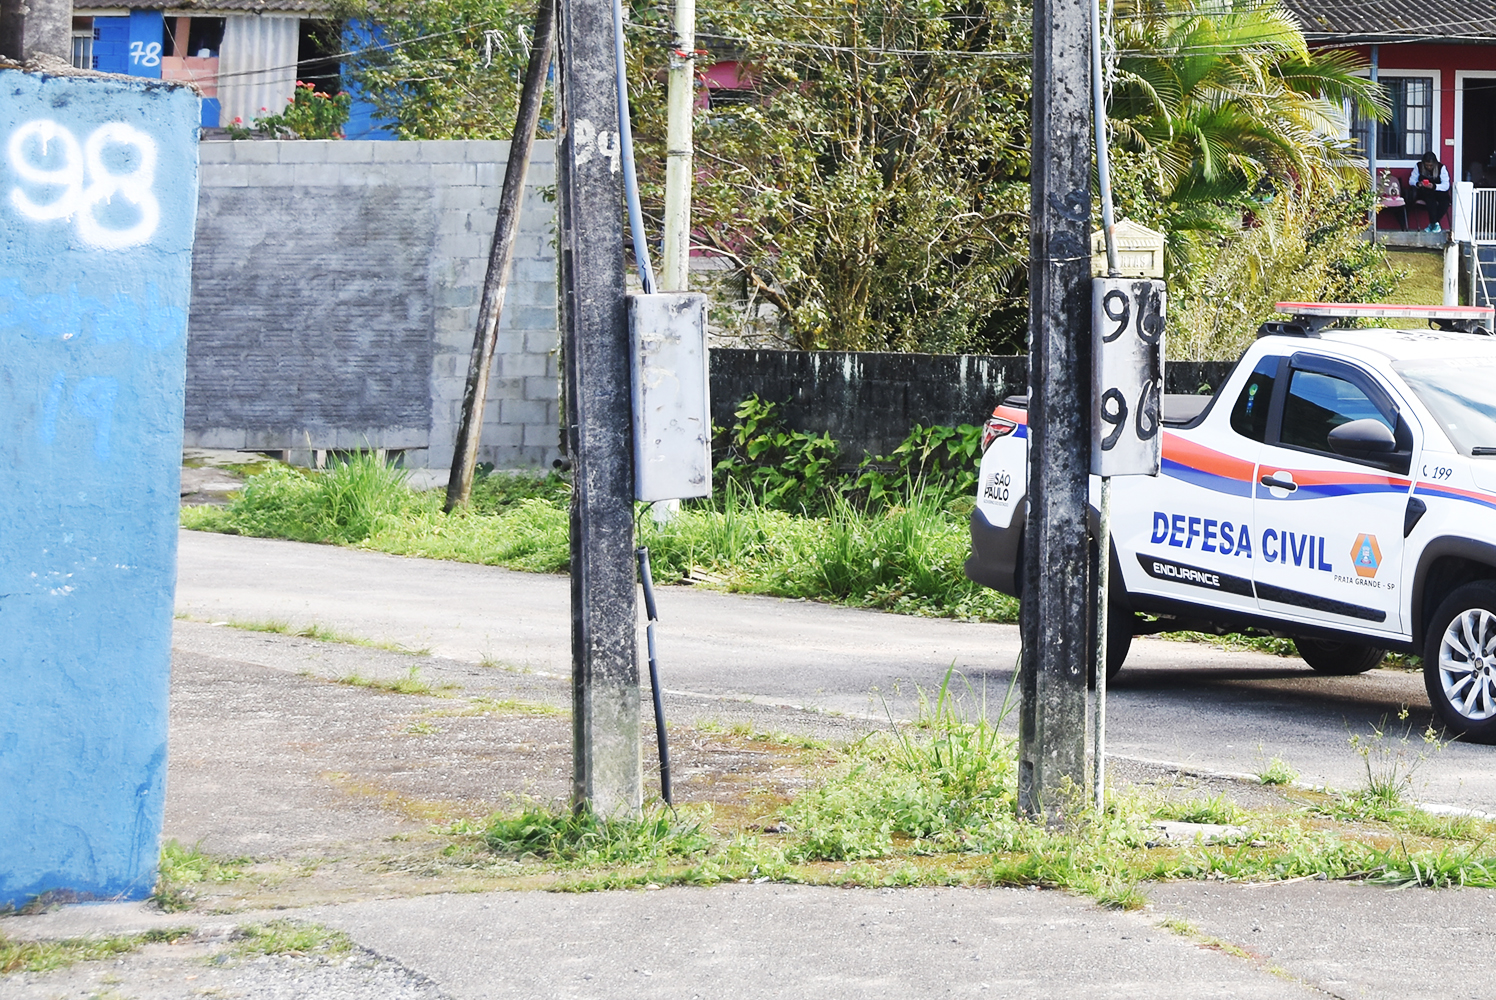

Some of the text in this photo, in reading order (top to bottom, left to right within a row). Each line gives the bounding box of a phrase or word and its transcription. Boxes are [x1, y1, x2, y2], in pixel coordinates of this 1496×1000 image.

[130, 41, 162, 67] 78
[9, 118, 160, 248] 98
[1120, 255, 1146, 267] RTAS
[994, 469, 1011, 487] SÃO
[1432, 466, 1453, 481] 199
[984, 486, 1010, 502] PAULO
[1150, 511, 1333, 572] DEFESA CIVIL
[1152, 561, 1221, 587] ENDURANCE
[1334, 574, 1354, 585] PRAIA
[1354, 577, 1381, 589] GRANDE
[1387, 582, 1396, 590] SP
